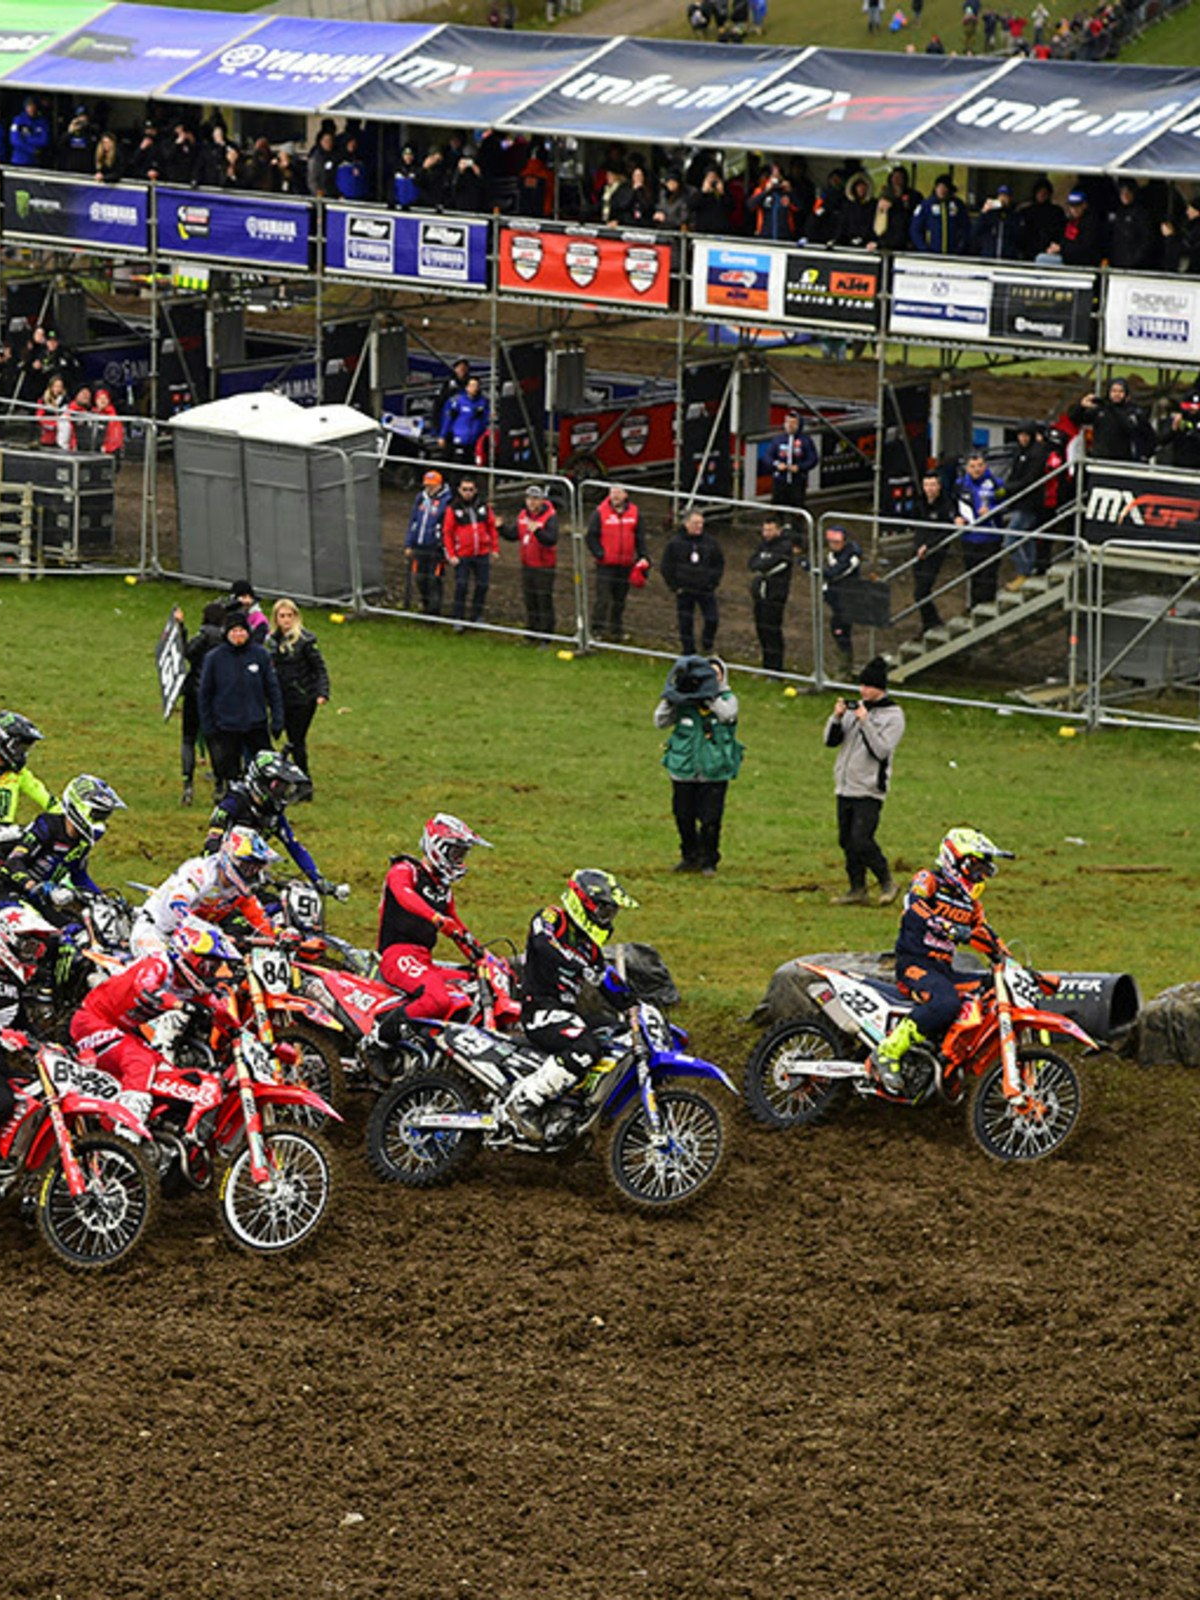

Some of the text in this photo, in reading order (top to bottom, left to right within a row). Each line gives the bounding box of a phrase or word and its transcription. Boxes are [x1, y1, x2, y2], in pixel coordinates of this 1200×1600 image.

[255, 48, 385, 75] YAMAHA
[835, 276, 870, 292] KTM
[1085, 487, 1200, 529] MXGP
[263, 960, 287, 985] 84
